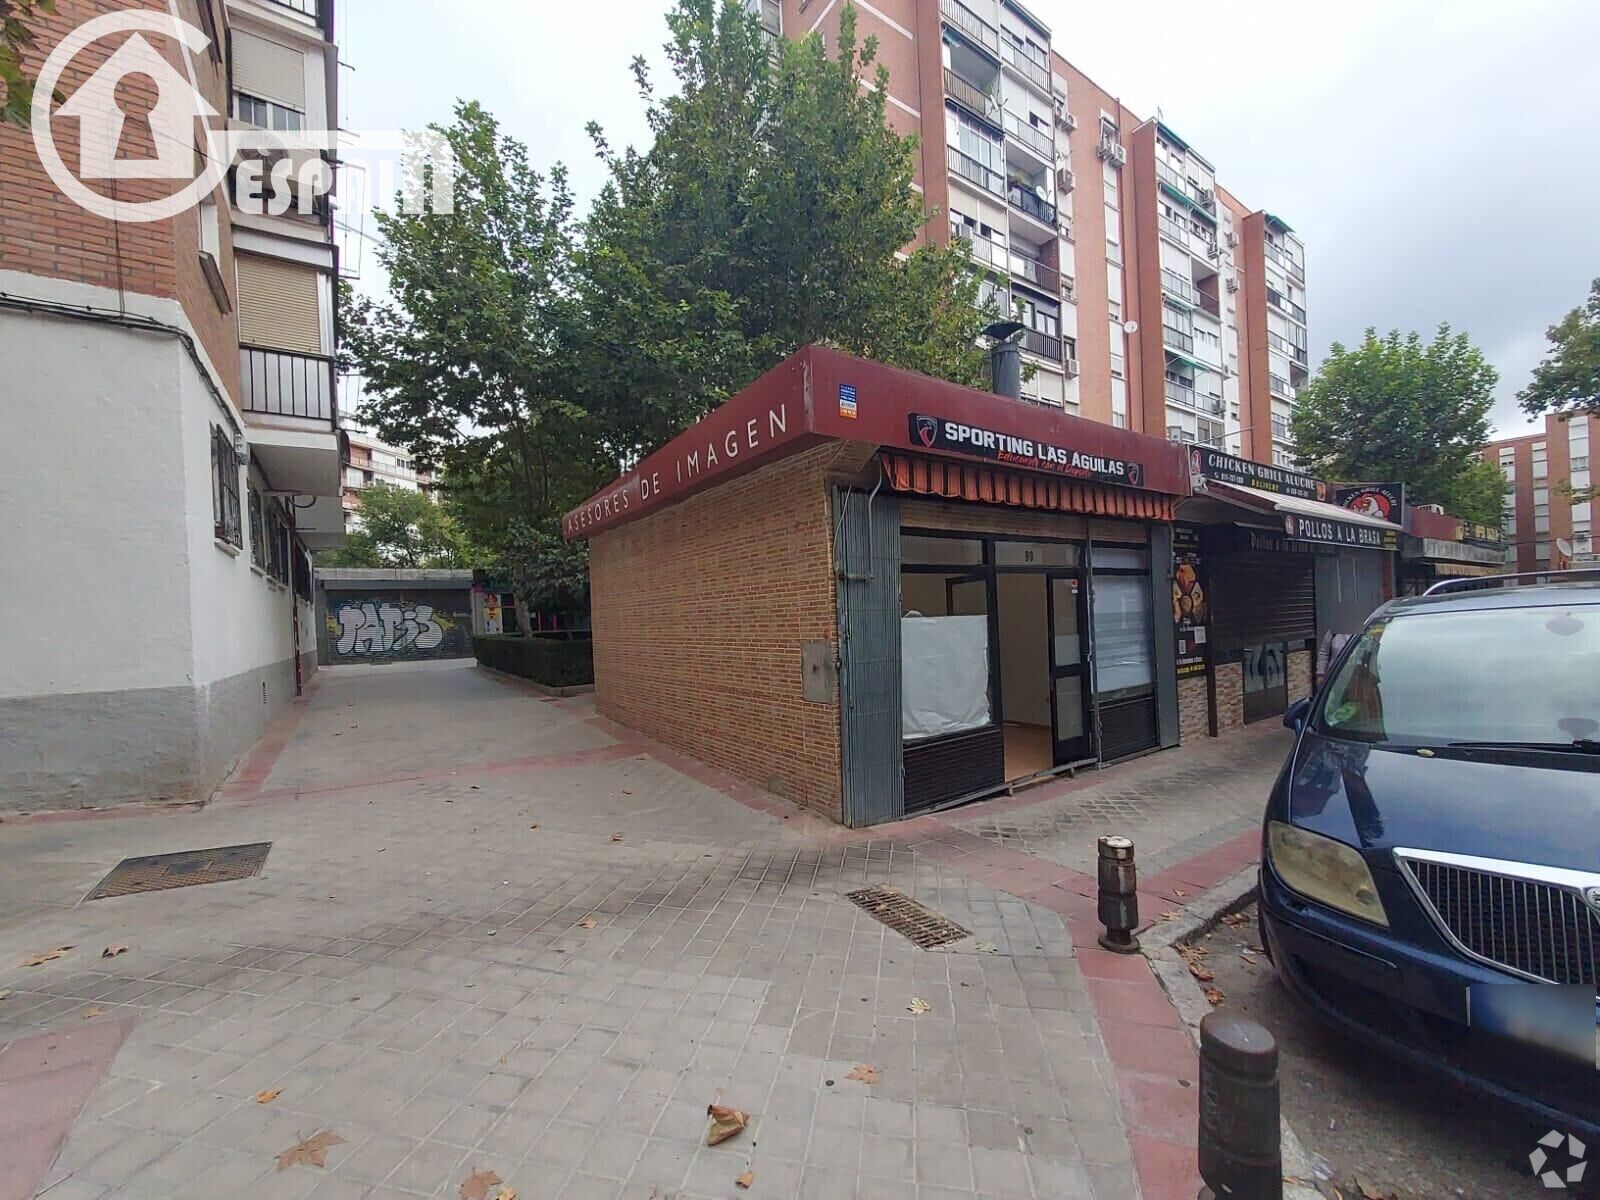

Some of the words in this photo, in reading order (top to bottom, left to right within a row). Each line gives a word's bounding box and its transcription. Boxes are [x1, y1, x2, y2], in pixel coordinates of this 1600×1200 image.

[945, 421, 1034, 458] SPORTING
[1038, 443, 1068, 466] LAS
[566, 488, 630, 535] ASESORES
[640, 471, 661, 501] DE
[676, 403, 788, 484] IMAGEN
[1208, 453, 1255, 476] CHICKEN
[1257, 466, 1284, 483] GRILL
[1284, 471, 1316, 490] ALUCHE
[1298, 518, 1333, 540] POLLOS
[1337, 526, 1343, 541] A
[1345, 527, 1356, 543] LA
[1359, 528, 1381, 545] BRASA
